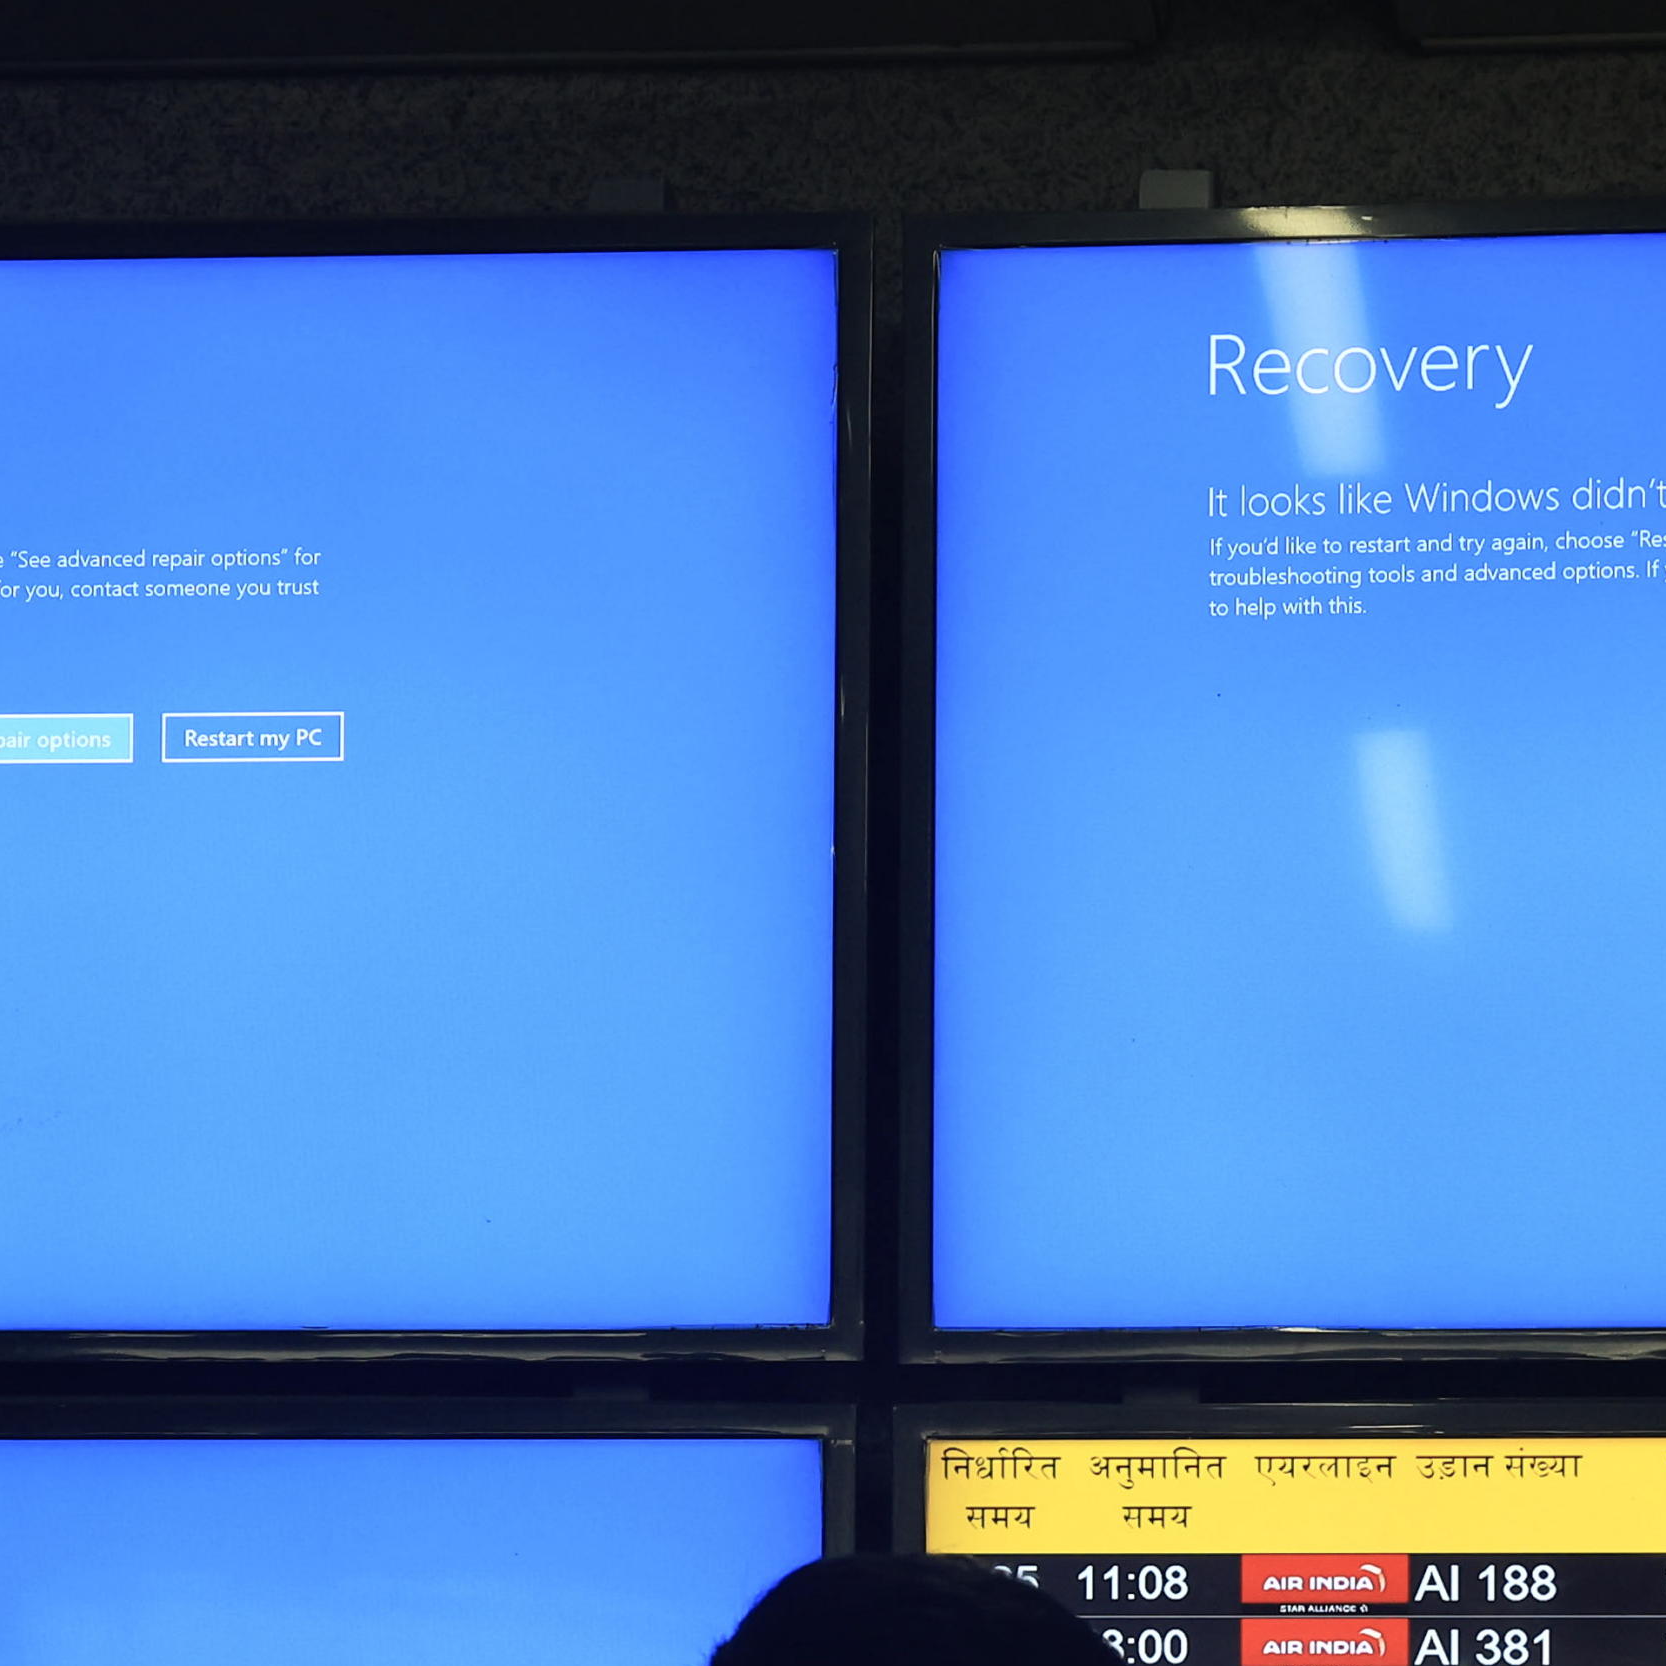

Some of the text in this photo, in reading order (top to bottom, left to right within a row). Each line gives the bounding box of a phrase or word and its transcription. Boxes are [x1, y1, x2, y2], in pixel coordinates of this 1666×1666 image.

[1209, 333, 1534, 410] Recovery
[1208, 486, 1228, 518] It
[1241, 483, 1326, 517] looks
[1339, 482, 1393, 515] like
[1404, 479, 1560, 513] Windows
[185, 728, 322, 751] Restart my PC
[940, 1446, 1062, 1480] निर्धारित
[1091, 1446, 1228, 1490] अनुमानित
[1254, 1455, 1398, 1478] एयरलाइन
[1415, 1455, 1583, 1480] उड़ान संख्या
[965, 1506, 1036, 1529] समय
[1122, 1505, 1193, 1529] समय
[1077, 1564, 1189, 1600] 11:08
[1262, 1576, 1374, 1591] AIR INDIA
[1414, 1564, 1557, 1602] AI 188
[1262, 1640, 1374, 1655] AIR INDIA
[1414, 1628, 1550, 1666] AI 381
